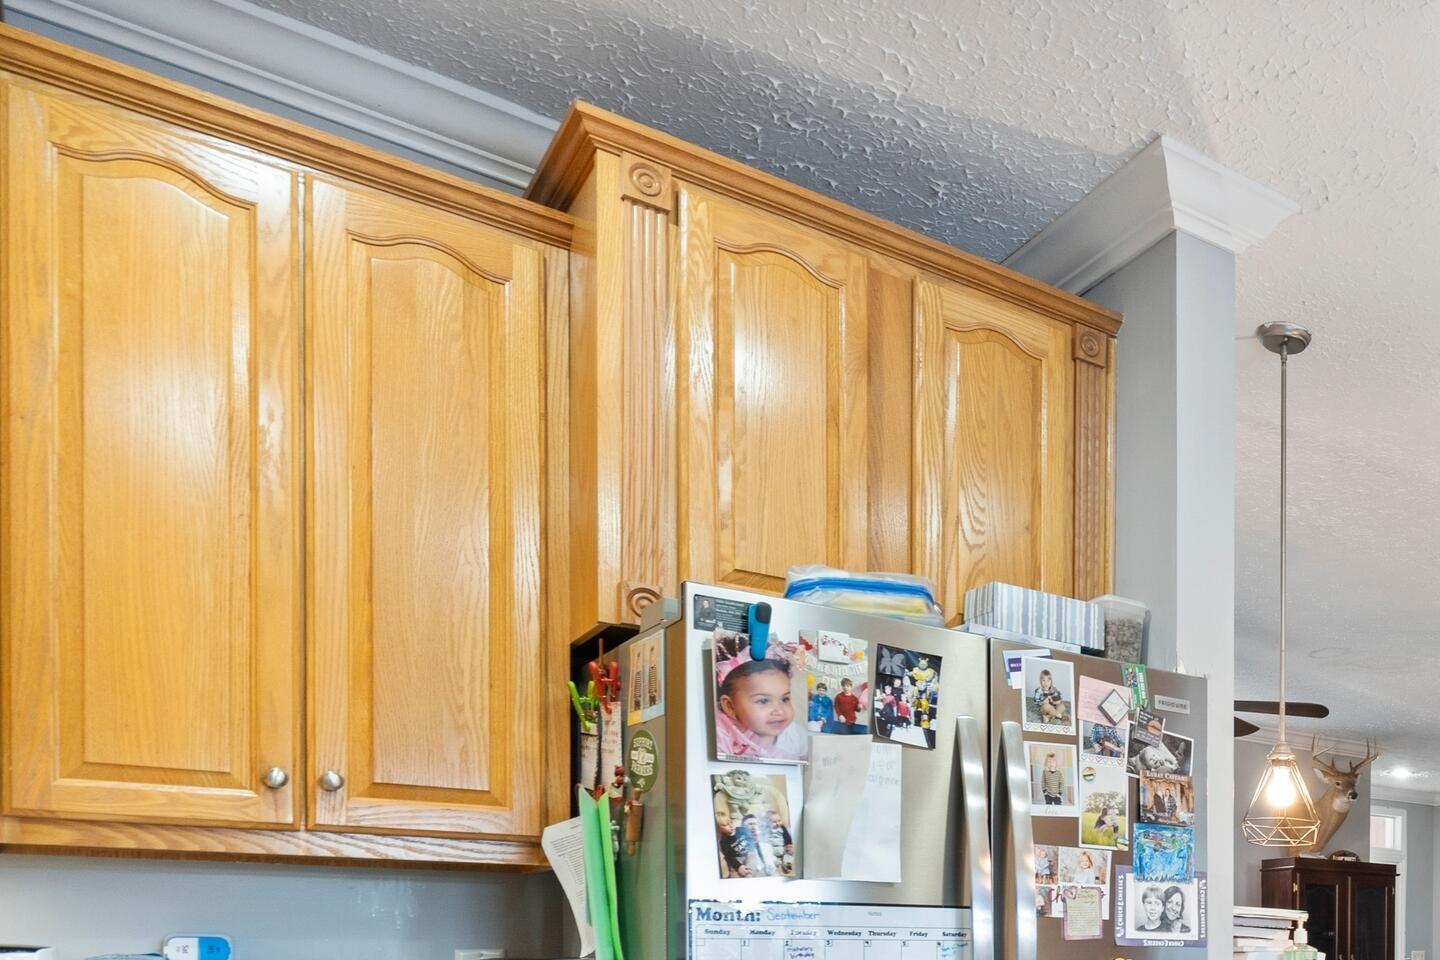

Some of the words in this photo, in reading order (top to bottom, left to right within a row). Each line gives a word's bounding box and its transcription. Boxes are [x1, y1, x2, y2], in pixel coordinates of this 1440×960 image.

[767, 907, 820, 921] September
[704, 928, 731, 936] Sunday
[827, 929, 862, 937] Wednesday
[868, 930, 896, 938] Thursday
